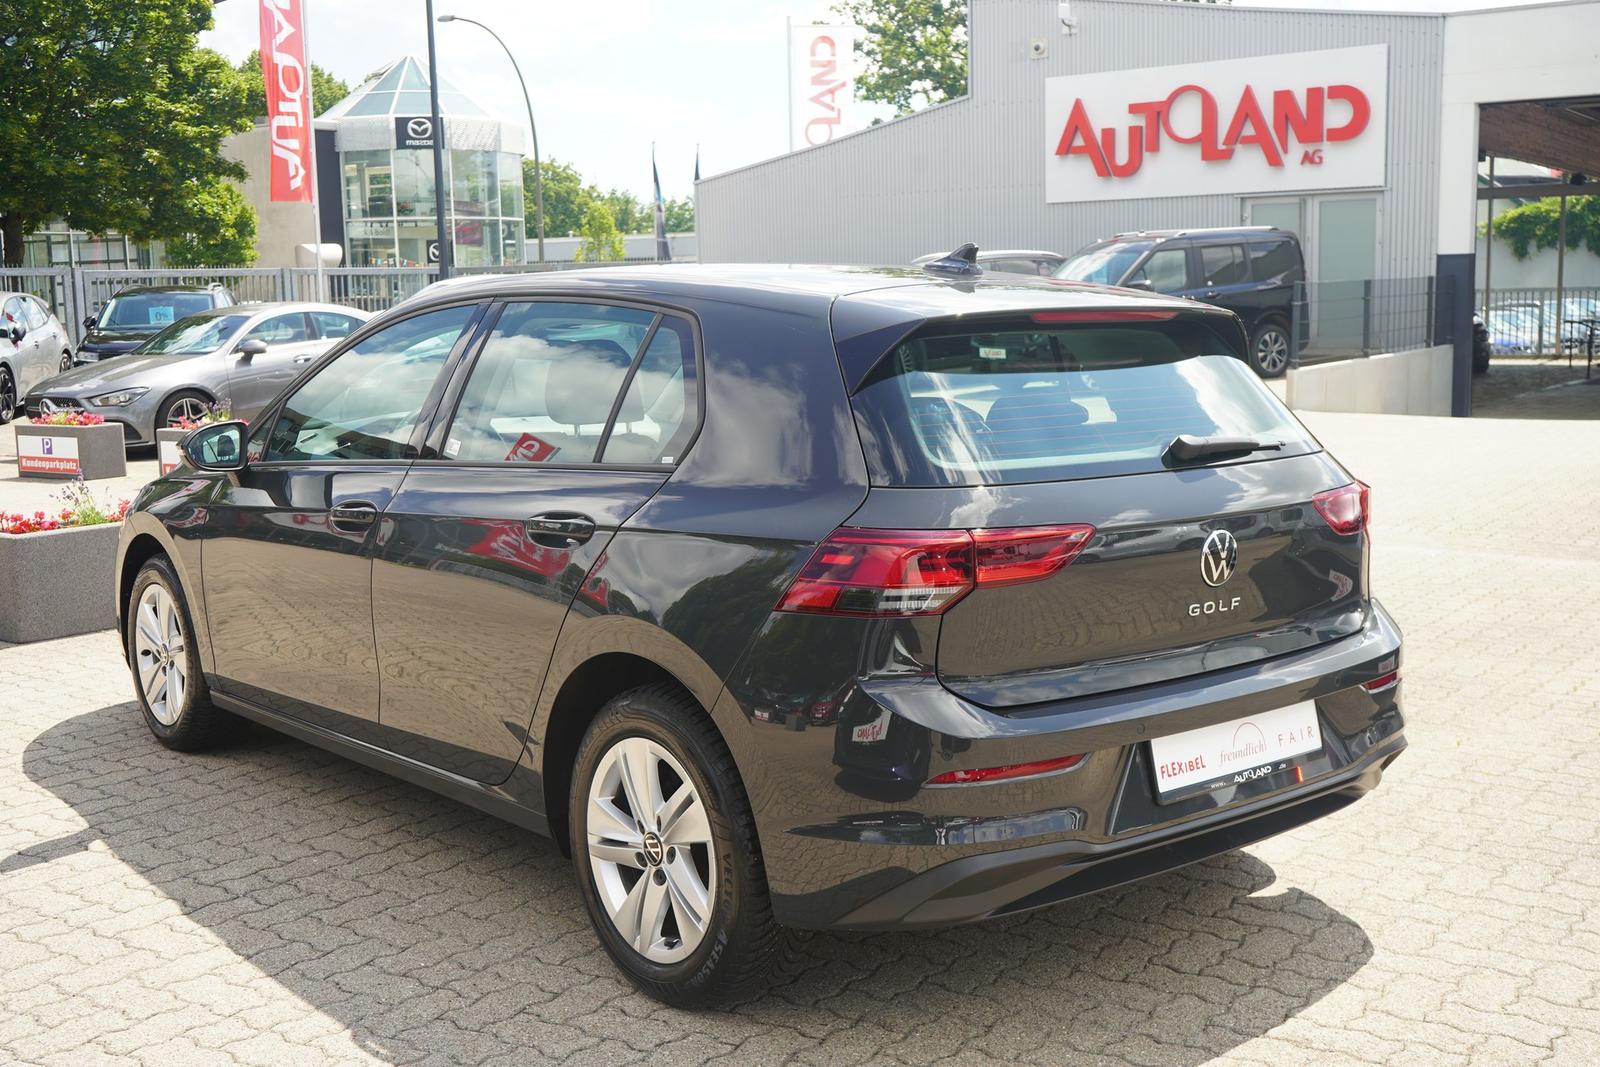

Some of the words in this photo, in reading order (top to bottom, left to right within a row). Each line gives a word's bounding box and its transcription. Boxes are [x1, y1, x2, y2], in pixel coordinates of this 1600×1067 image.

[1055, 83, 1371, 178] AUTOLAND
[1300, 149, 1324, 165] AG
[21, 458, 77, 471] Kundenparkplatz
[1188, 596, 1241, 617] GOLF
[1278, 725, 1314, 747] FAIR
[1233, 765, 1272, 783] AUTOLAND
